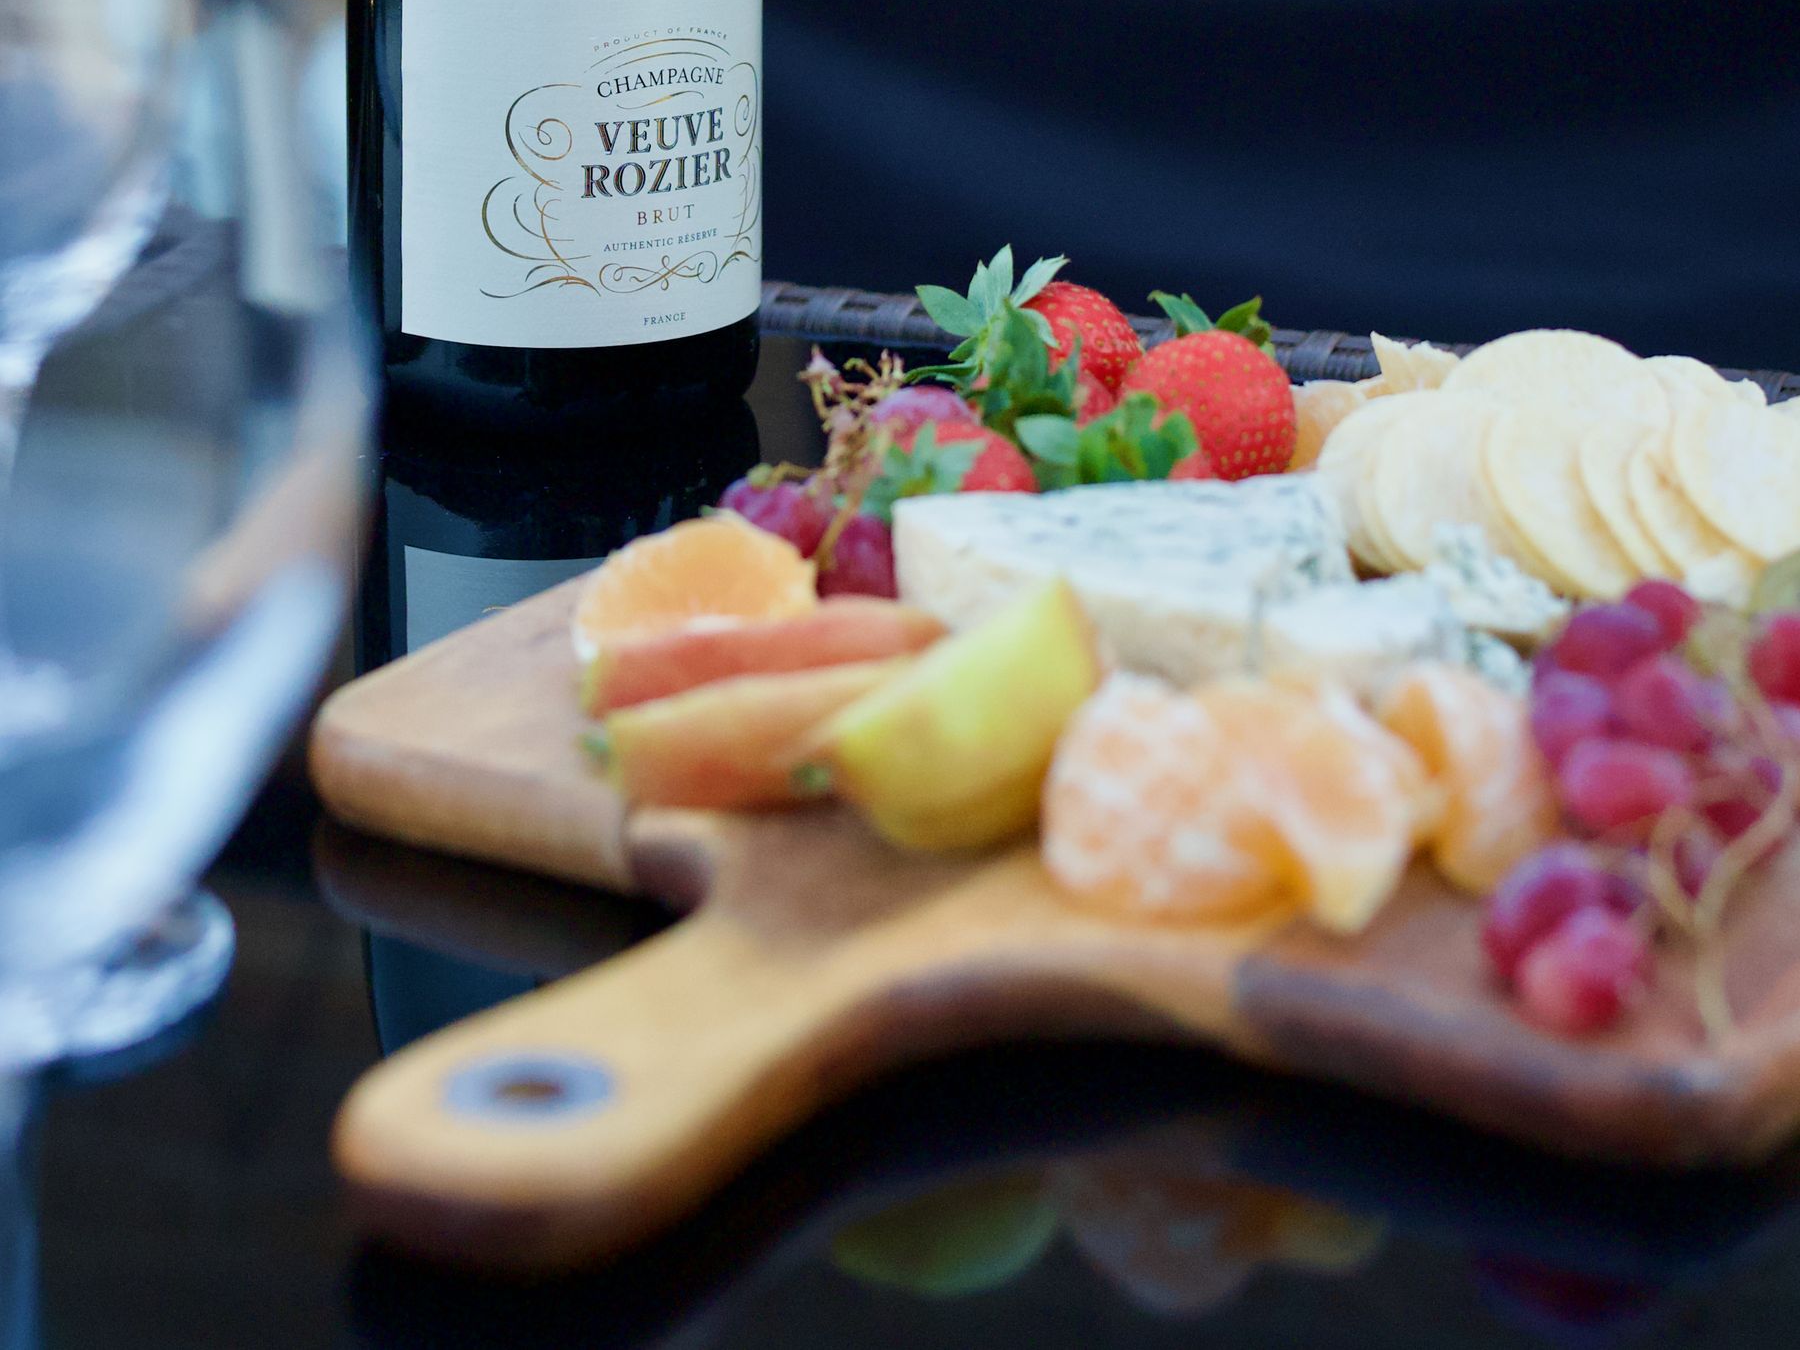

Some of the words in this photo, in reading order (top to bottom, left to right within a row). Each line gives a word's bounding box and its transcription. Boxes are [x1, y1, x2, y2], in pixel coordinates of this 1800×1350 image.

[593, 29, 658, 52] PRODUCT
[667, 26, 681, 35] OF
[689, 26, 728, 41] FRANCE
[596, 66, 725, 99] CHAMPAGNE
[594, 106, 724, 156] VEUVE
[580, 147, 732, 199] ROZIER
[637, 203, 696, 226] BRUT
[603, 236, 674, 252] AUTHENTIC
[678, 227, 718, 245] RÉSERVE
[643, 311, 687, 326] FRANCE
